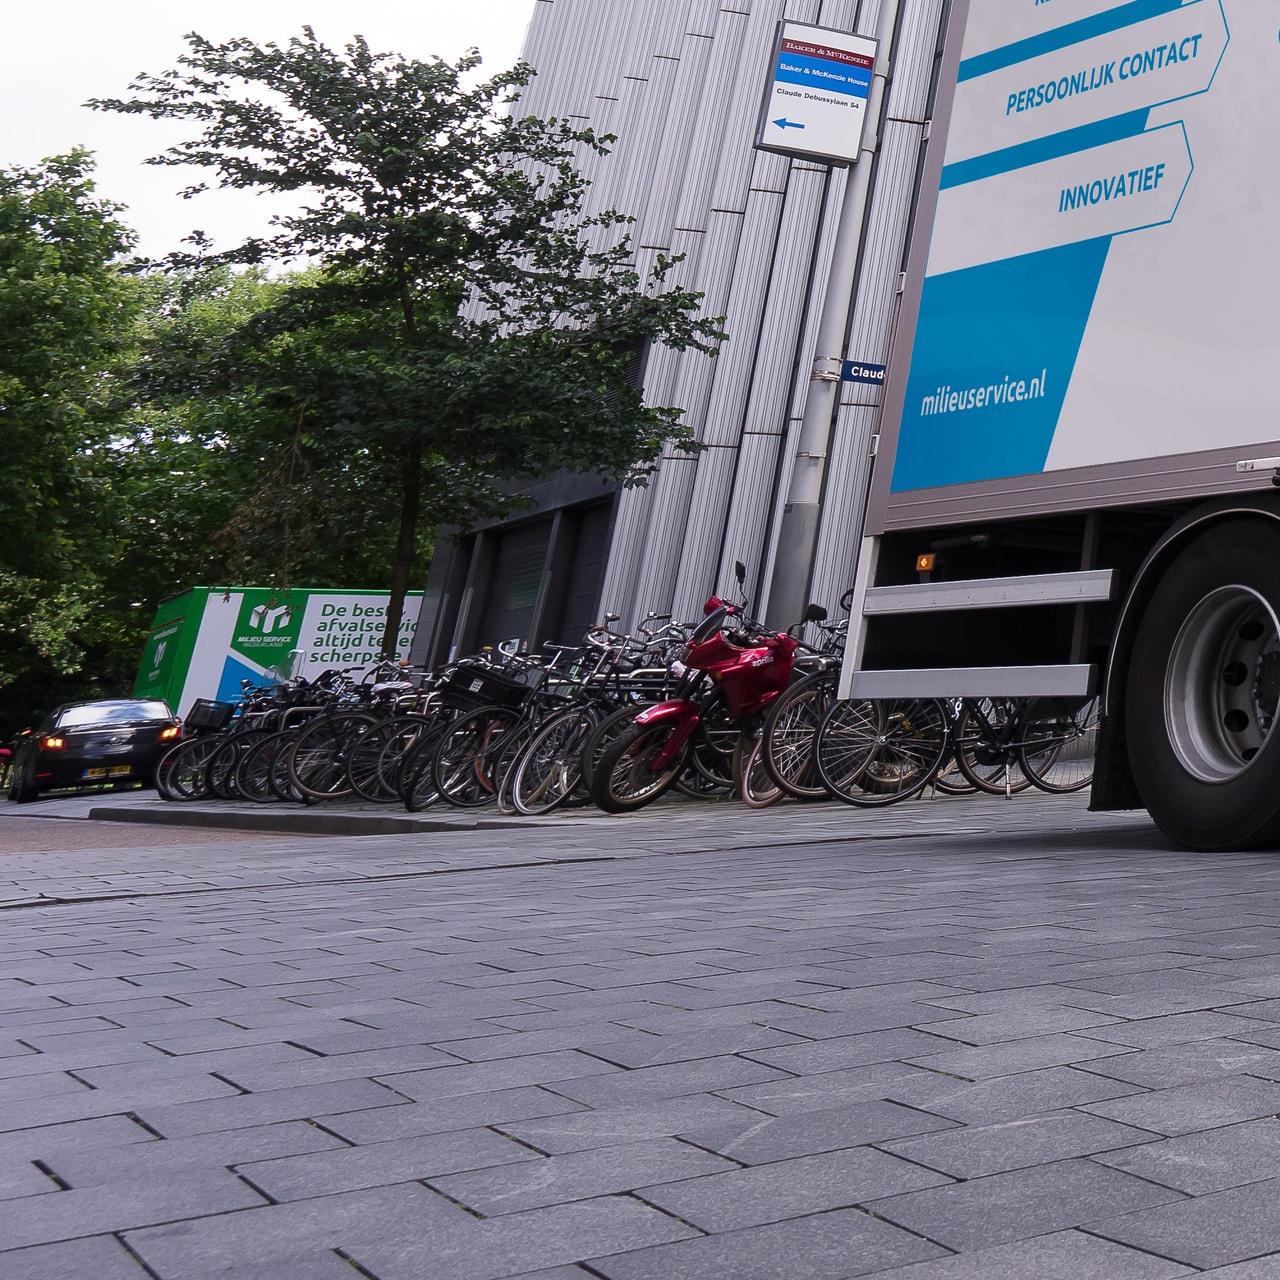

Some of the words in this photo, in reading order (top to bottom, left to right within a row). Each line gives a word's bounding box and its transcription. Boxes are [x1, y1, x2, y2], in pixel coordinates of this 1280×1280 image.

[780, 63, 802, 73] Baker
[812, 69, 846, 82] McKenzie
[847, 77, 869, 87] House
[1006, 61, 1116, 116] PERSOONLIJK
[1119, 33, 1202, 80] CONTACT
[776, 88, 802, 98] Claude
[804, 93, 848, 107] Debussylaan
[1059, 163, 1165, 212] INNOVATIEF
[851, 366, 886, 380] Claud
[921, 368, 1046, 417] milieuservice.nl
[321, 604, 347, 617] De
[313, 634, 364, 650] altijd
[309, 649, 402, 665] scherpse
